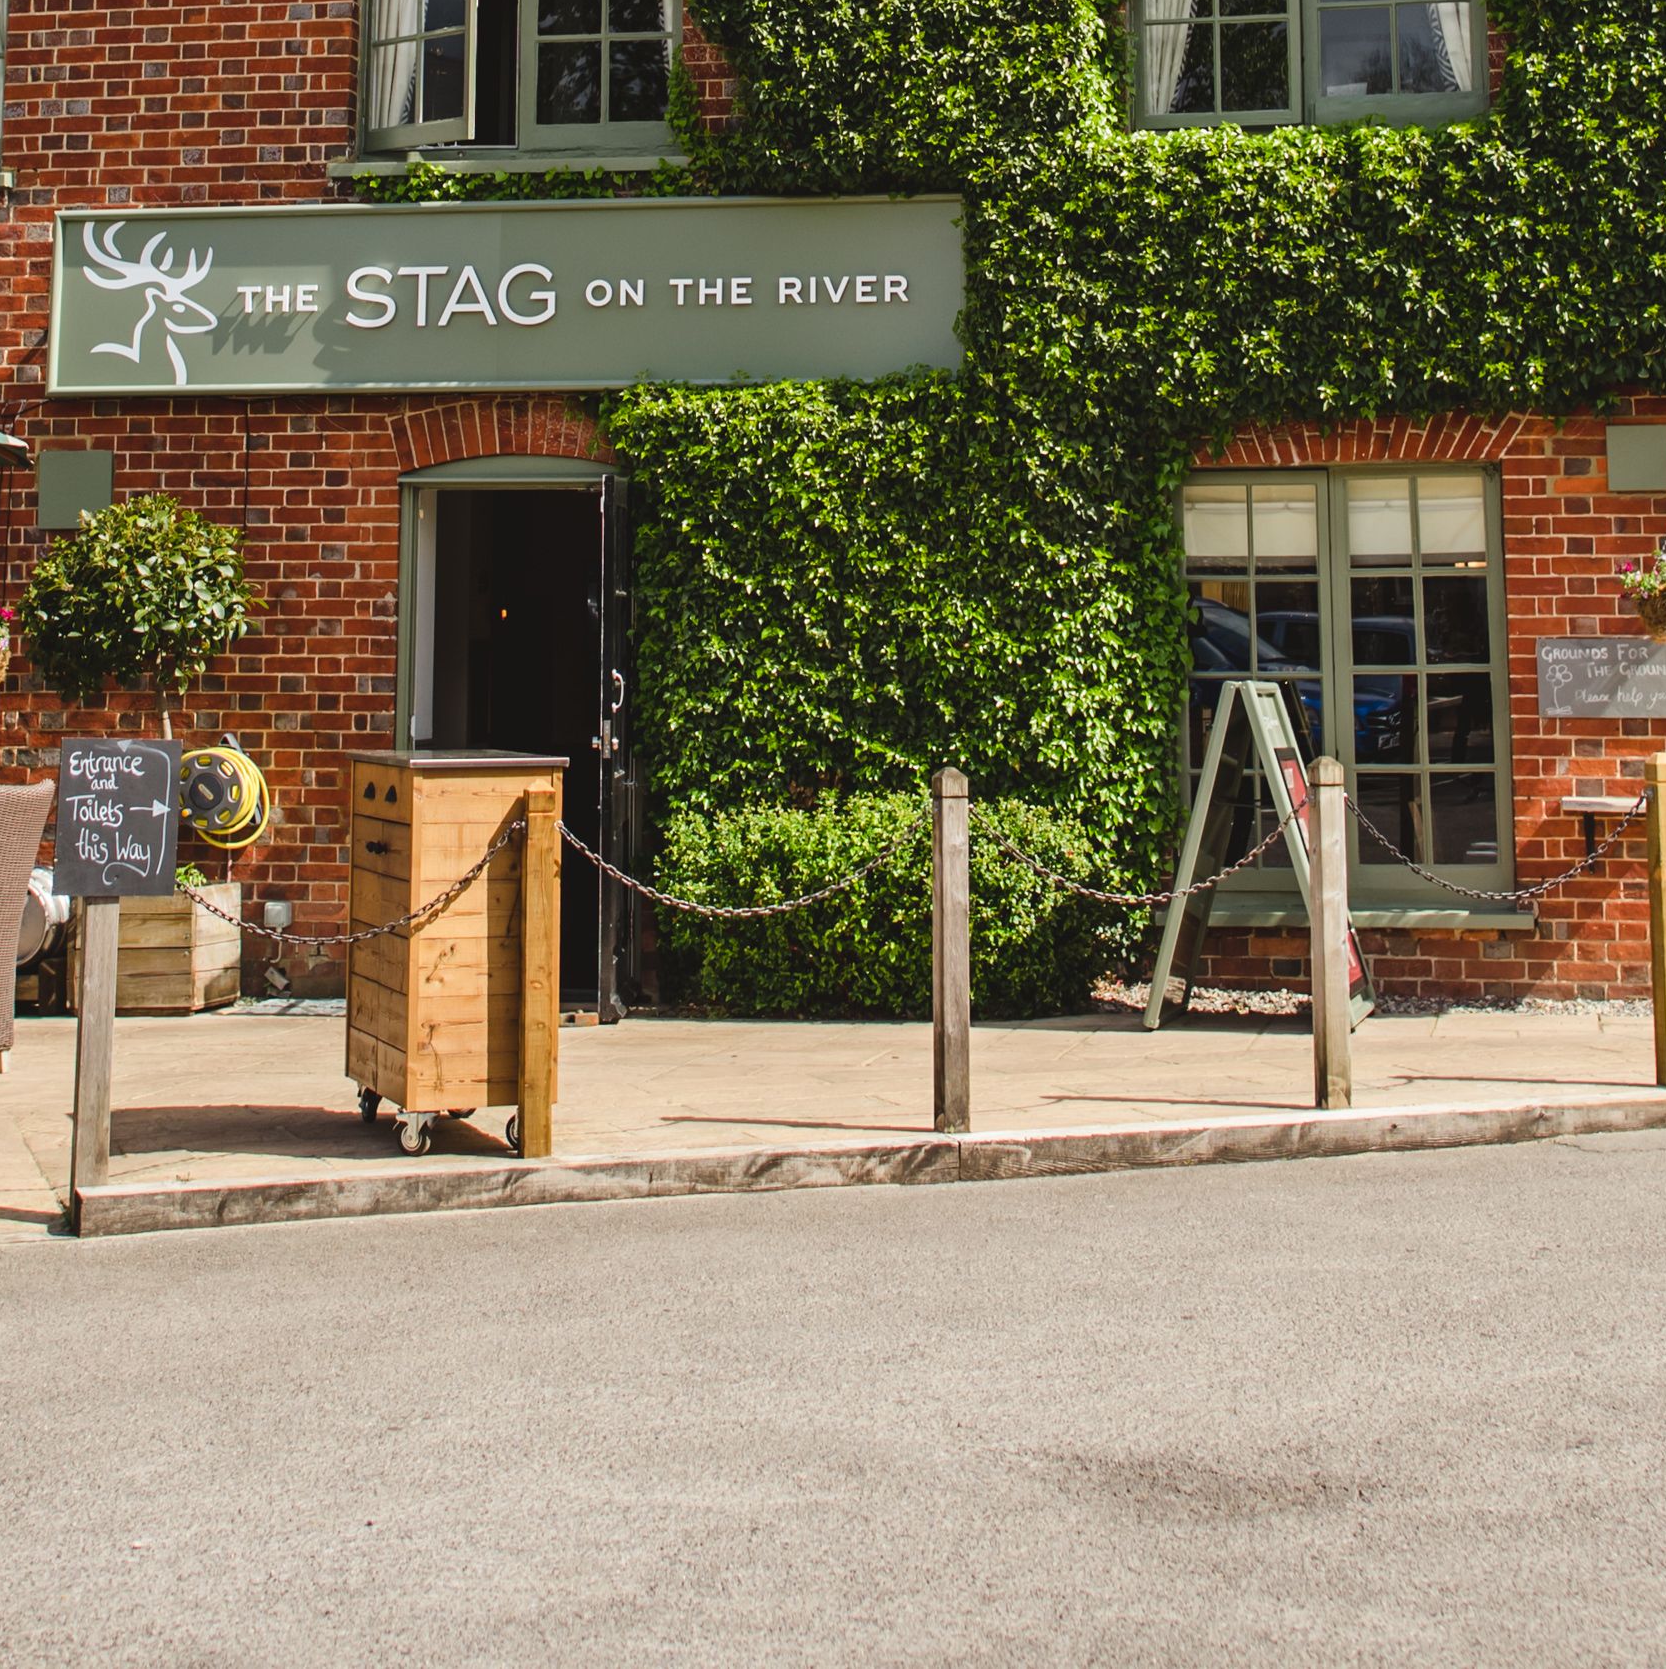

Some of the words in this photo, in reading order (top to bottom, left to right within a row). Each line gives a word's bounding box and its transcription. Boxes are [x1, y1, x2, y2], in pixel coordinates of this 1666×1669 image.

[236, 284, 319, 314] THE
[345, 263, 557, 328] STAG
[584, 278, 645, 307] ON
[669, 277, 753, 306] THE
[778, 274, 910, 305] RIVER
[1575, 688, 1611, 703] Please
[1617, 685, 1644, 707] help
[69, 751, 145, 779] Entrance
[91, 774, 119, 790] and
[65, 794, 124, 827] Toilets
[75, 827, 108, 864] this
[109, 831, 151, 880] Way
